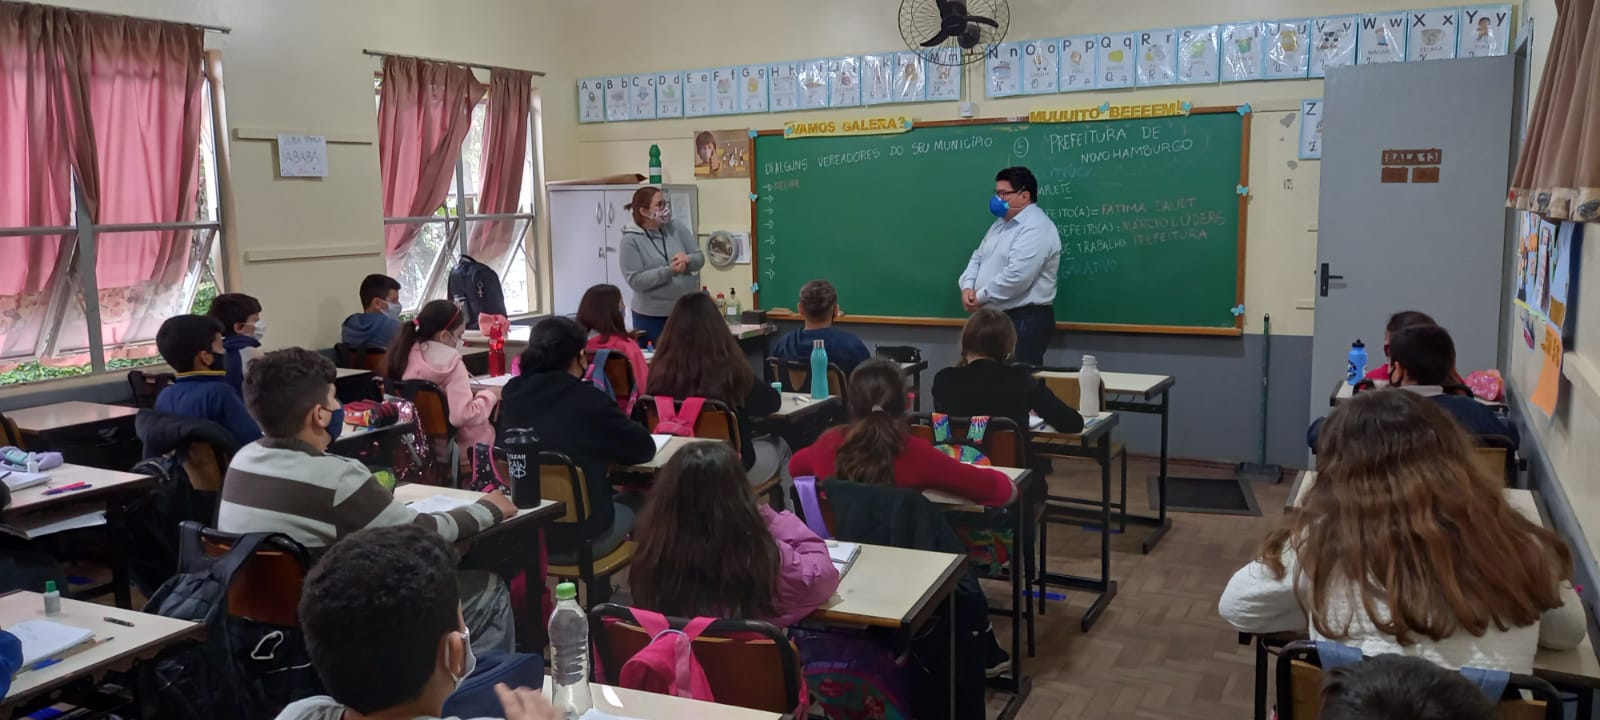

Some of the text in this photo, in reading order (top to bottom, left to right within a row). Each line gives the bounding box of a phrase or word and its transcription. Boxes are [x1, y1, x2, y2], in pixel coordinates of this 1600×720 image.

[1363, 17, 1403, 29] W w
[1413, 13, 1453, 27] X x
[1465, 10, 1506, 26] Y y
[1270, 24, 1280, 36] U
[1316, 20, 1326, 33] V
[1141, 33, 1172, 45] R r
[1184, 31, 1192, 42] S
[1063, 40, 1094, 53] P p
[1101, 36, 1132, 50] Q q
[988, 46, 1018, 59] N n
[1026, 44, 1036, 55] O
[930, 52, 939, 61] M
[713, 69, 735, 81] F f
[742, 68, 764, 79] G g
[772, 66, 779, 77] H
[607, 77, 628, 89] B b
[632, 76, 640, 87] C
[659, 74, 680, 85] D d
[687, 73, 707, 83] E e
[581, 81, 602, 91] A a
[1305, 102, 1317, 115] Z
[792, 117, 905, 135] VAMOS GALERA?
[1050, 125, 1160, 153] PREFEITURA DE
[817, 149, 880, 168] VEREADORES
[890, 145, 904, 156] DO
[911, 142, 930, 155] SEU
[934, 135, 993, 151] MUNICÍPIO
[1081, 138, 1193, 164] NOVO HAMBURGO
[1037, 182, 1072, 196] MPLETE
